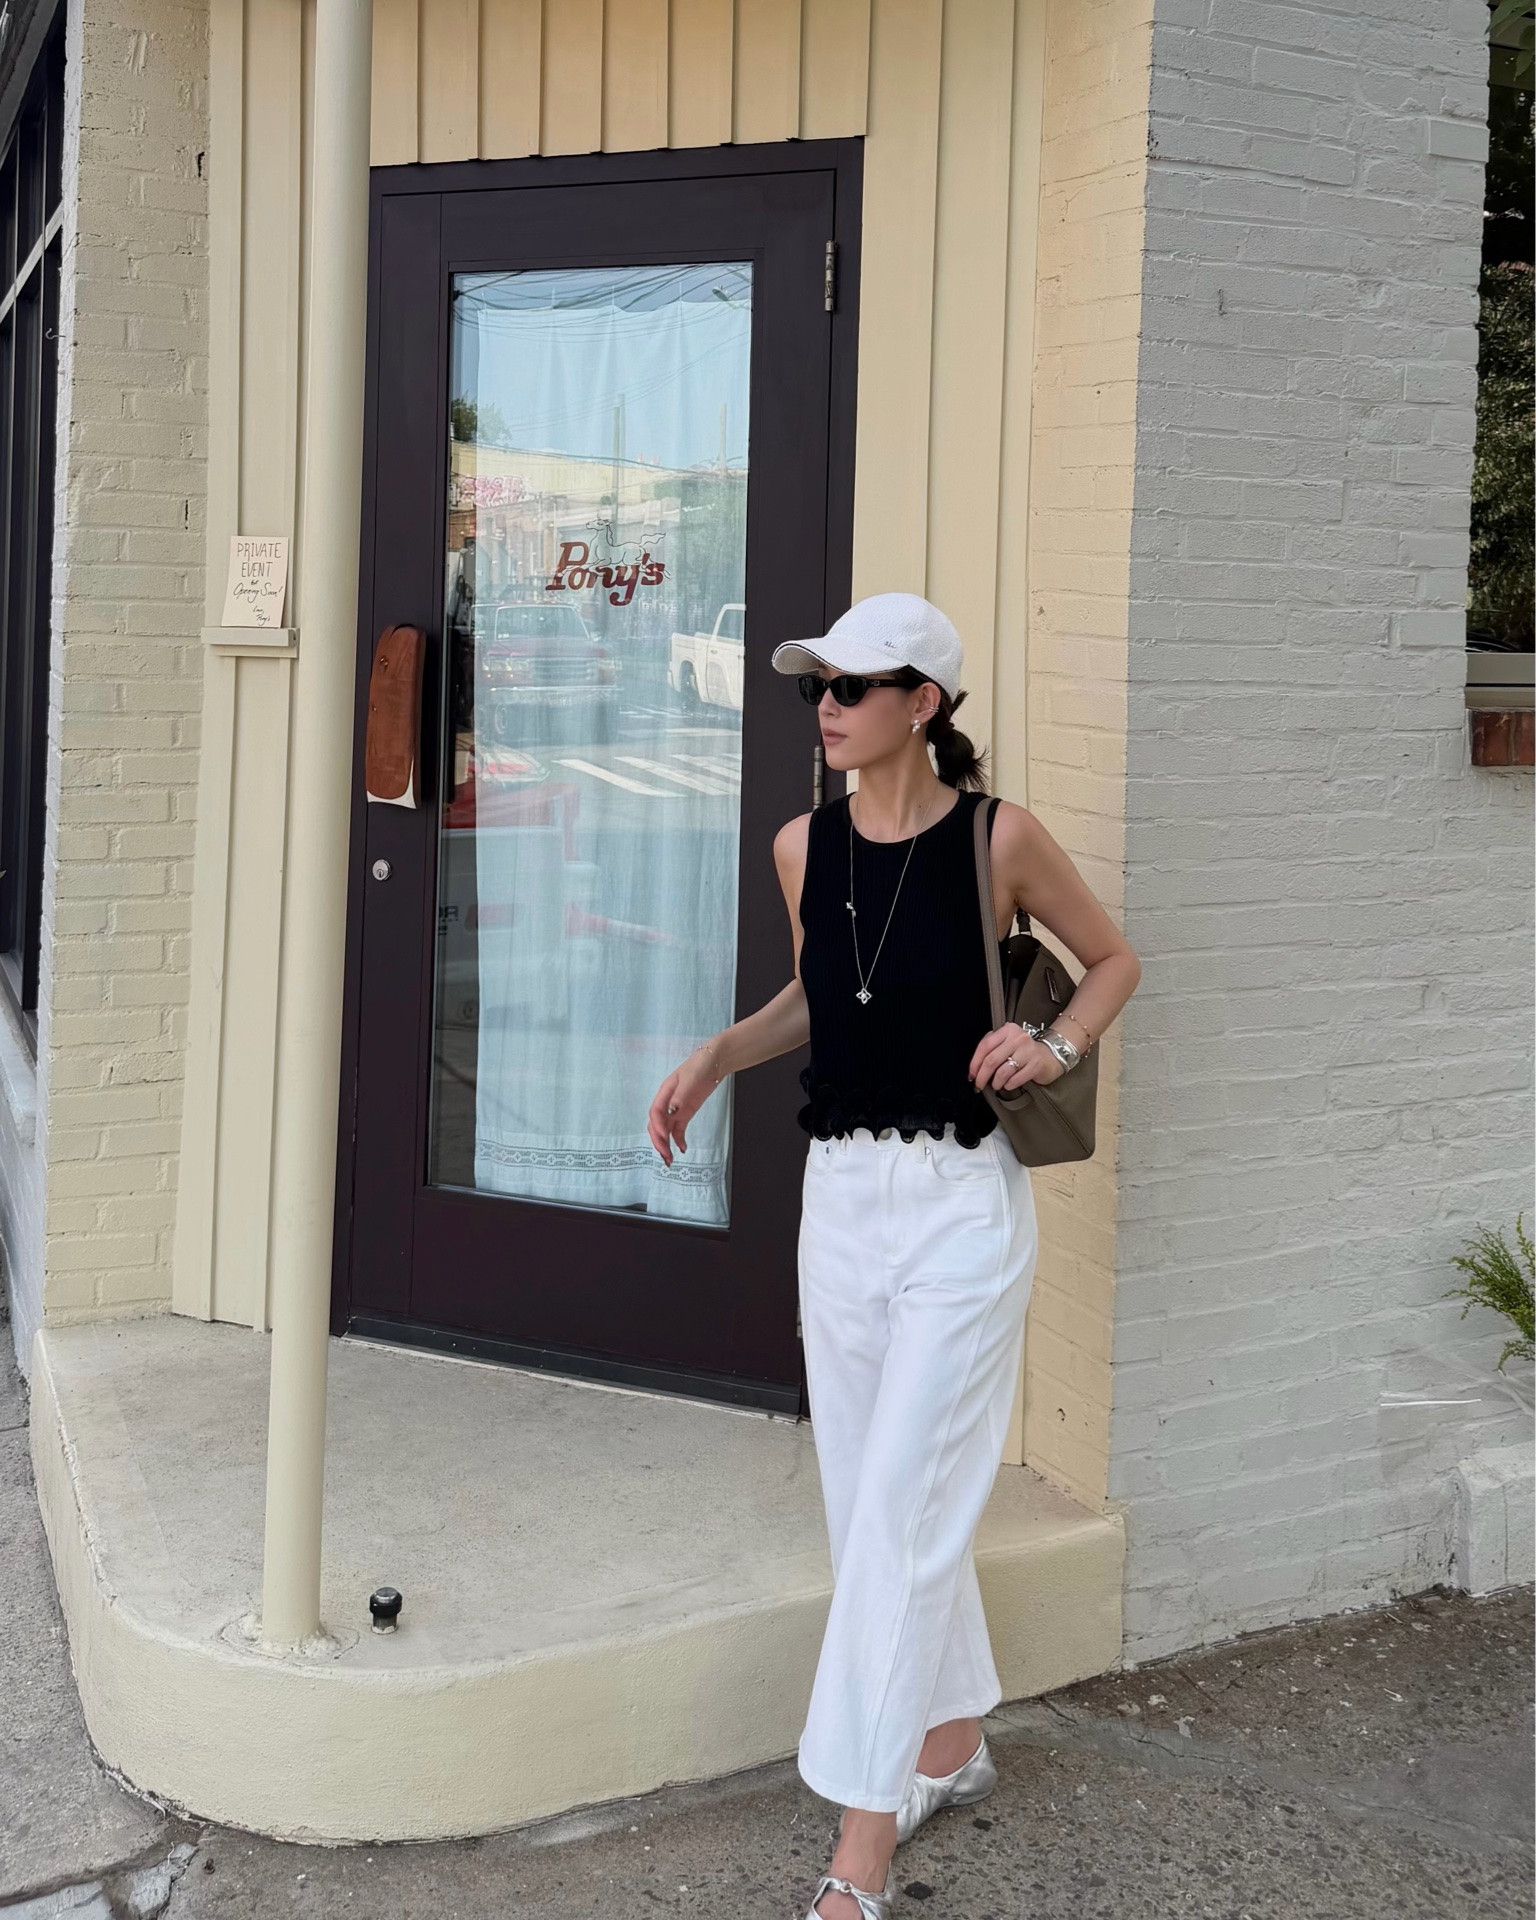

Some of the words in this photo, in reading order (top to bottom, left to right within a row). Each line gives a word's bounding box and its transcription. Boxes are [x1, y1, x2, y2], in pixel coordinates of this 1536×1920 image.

[237, 542, 281, 561] PRIVATE
[241, 561, 273, 578] EVENT
[545, 541, 666, 606] Pony's
